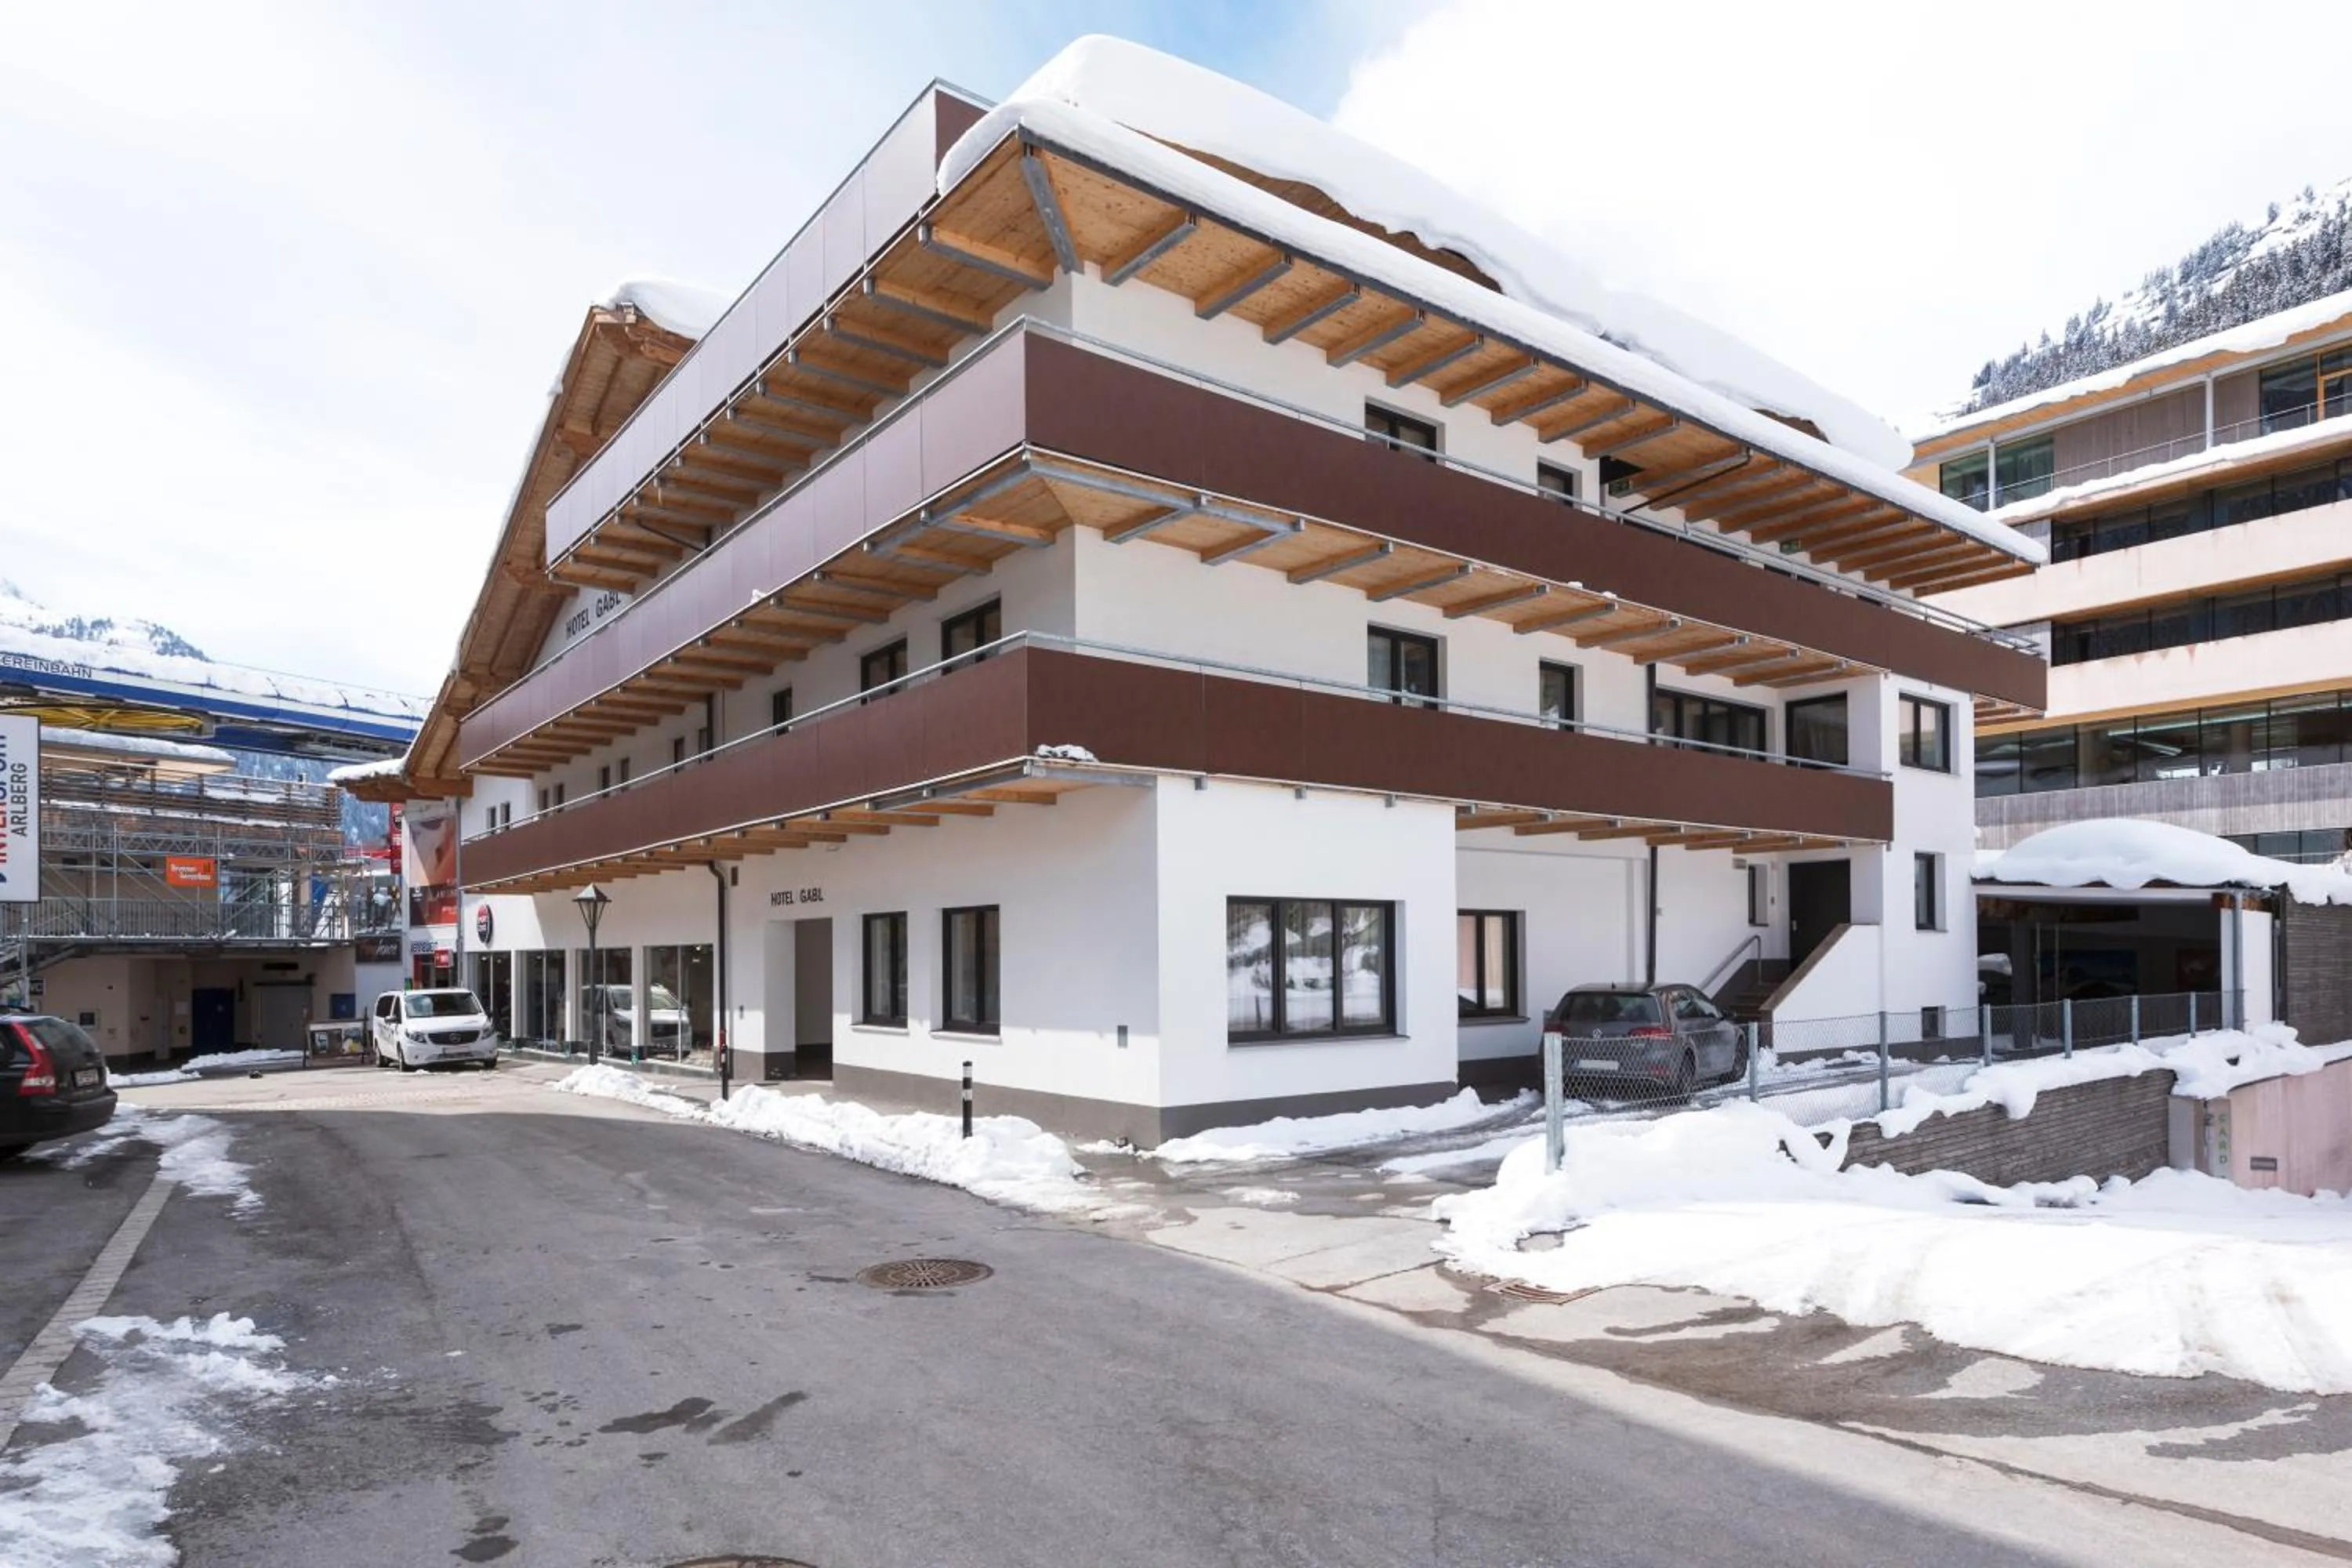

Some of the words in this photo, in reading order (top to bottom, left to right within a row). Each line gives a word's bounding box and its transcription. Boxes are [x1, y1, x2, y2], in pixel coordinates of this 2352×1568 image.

[565, 608, 590, 641] HOTEL
[596, 590, 622, 618] GABL
[0, 655, 92, 678] EREINBAHN
[10, 763, 27, 837] ARLBERG
[771, 891, 794, 906] HOTEL
[800, 887, 825, 904] GABL
